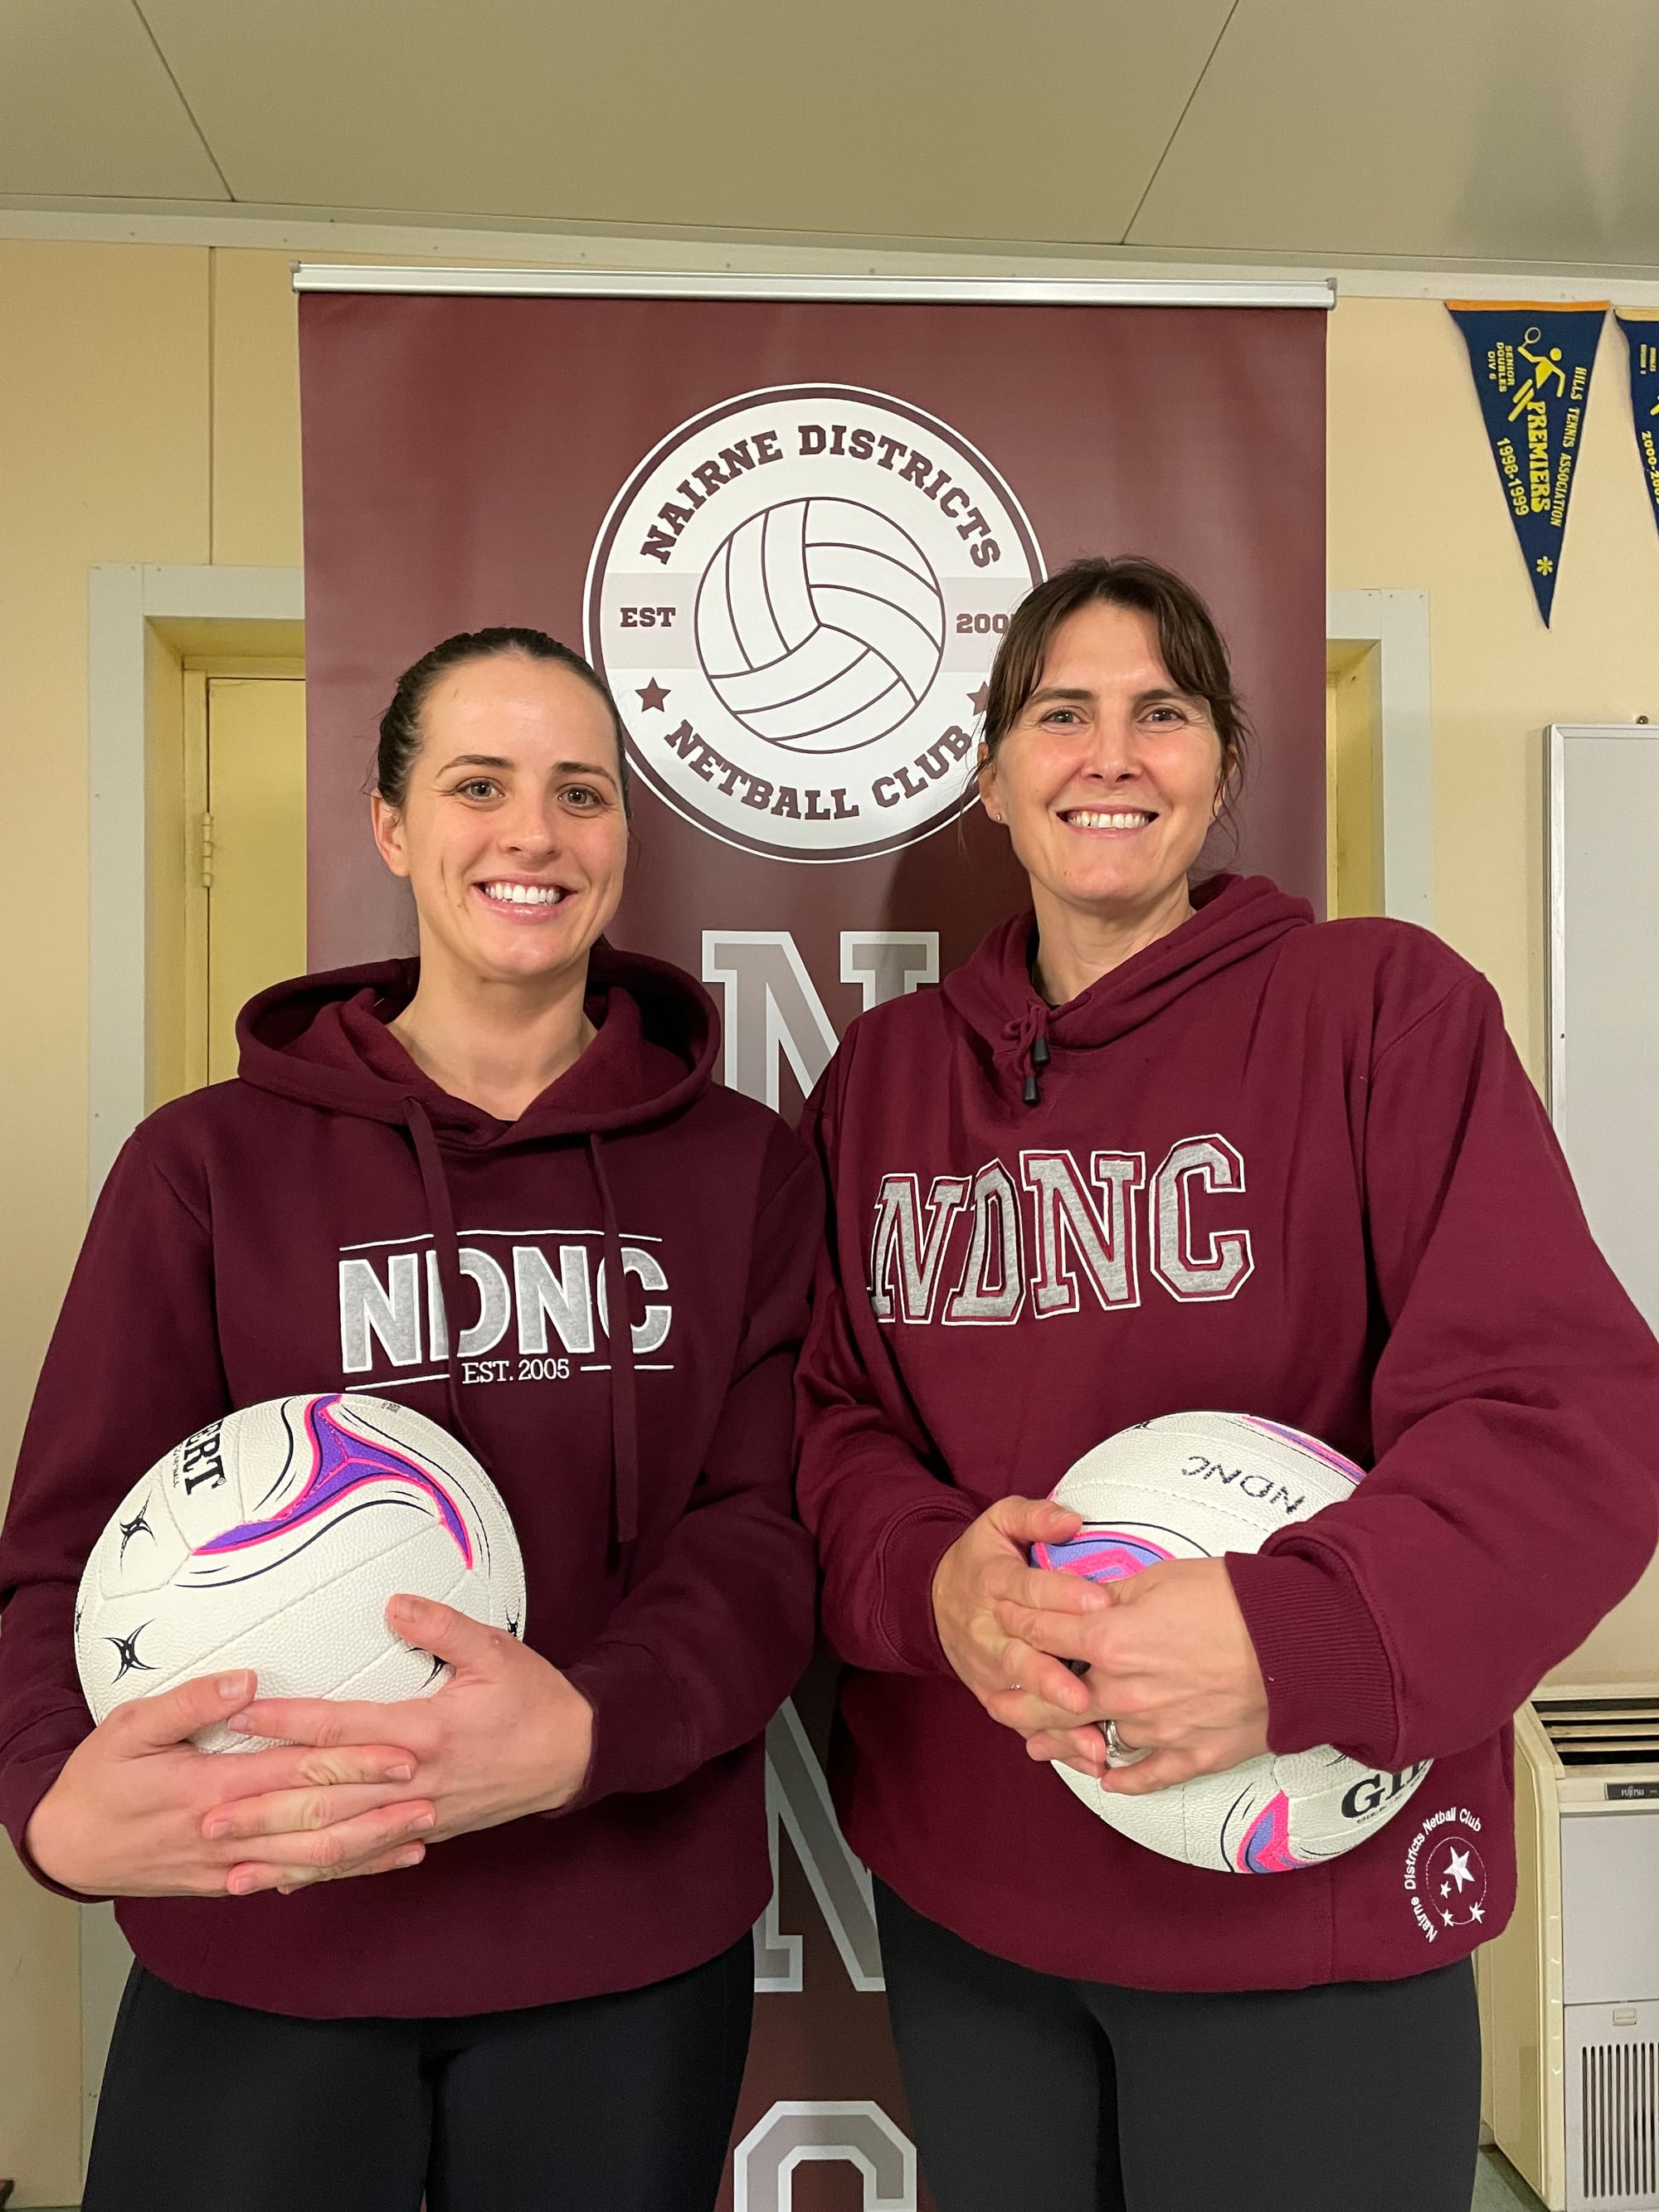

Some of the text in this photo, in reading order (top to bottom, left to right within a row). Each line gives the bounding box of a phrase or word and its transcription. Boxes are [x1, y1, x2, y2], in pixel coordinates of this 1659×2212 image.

[1487, 351, 1496, 370] DIV
[1496, 342, 1507, 392] DOUBLES
[1505, 345, 1515, 386] SENIOR
[1527, 401, 1551, 513] PREMIERS
[1550, 366, 1587, 527] HILLS TENNIS ASSOCIATION
[1642, 430, 1659, 504] 2000-200
[640, 425, 1001, 568] NAIRNE DISTRICTS
[620, 607, 676, 628] EST
[956, 613, 1010, 634] 200
[664, 719, 973, 820] NETBALL CLUB
[867, 1133, 1255, 1326] NDNC
[338, 1245, 673, 1373] NDNC
[462, 1358, 570, 1384] EST. 2005
[1181, 1456, 1307, 1515] NDNC
[1621, 1785, 1645, 1798] FUJITSU
[1404, 1806, 1481, 1943] Nairne Districts Netball Club
